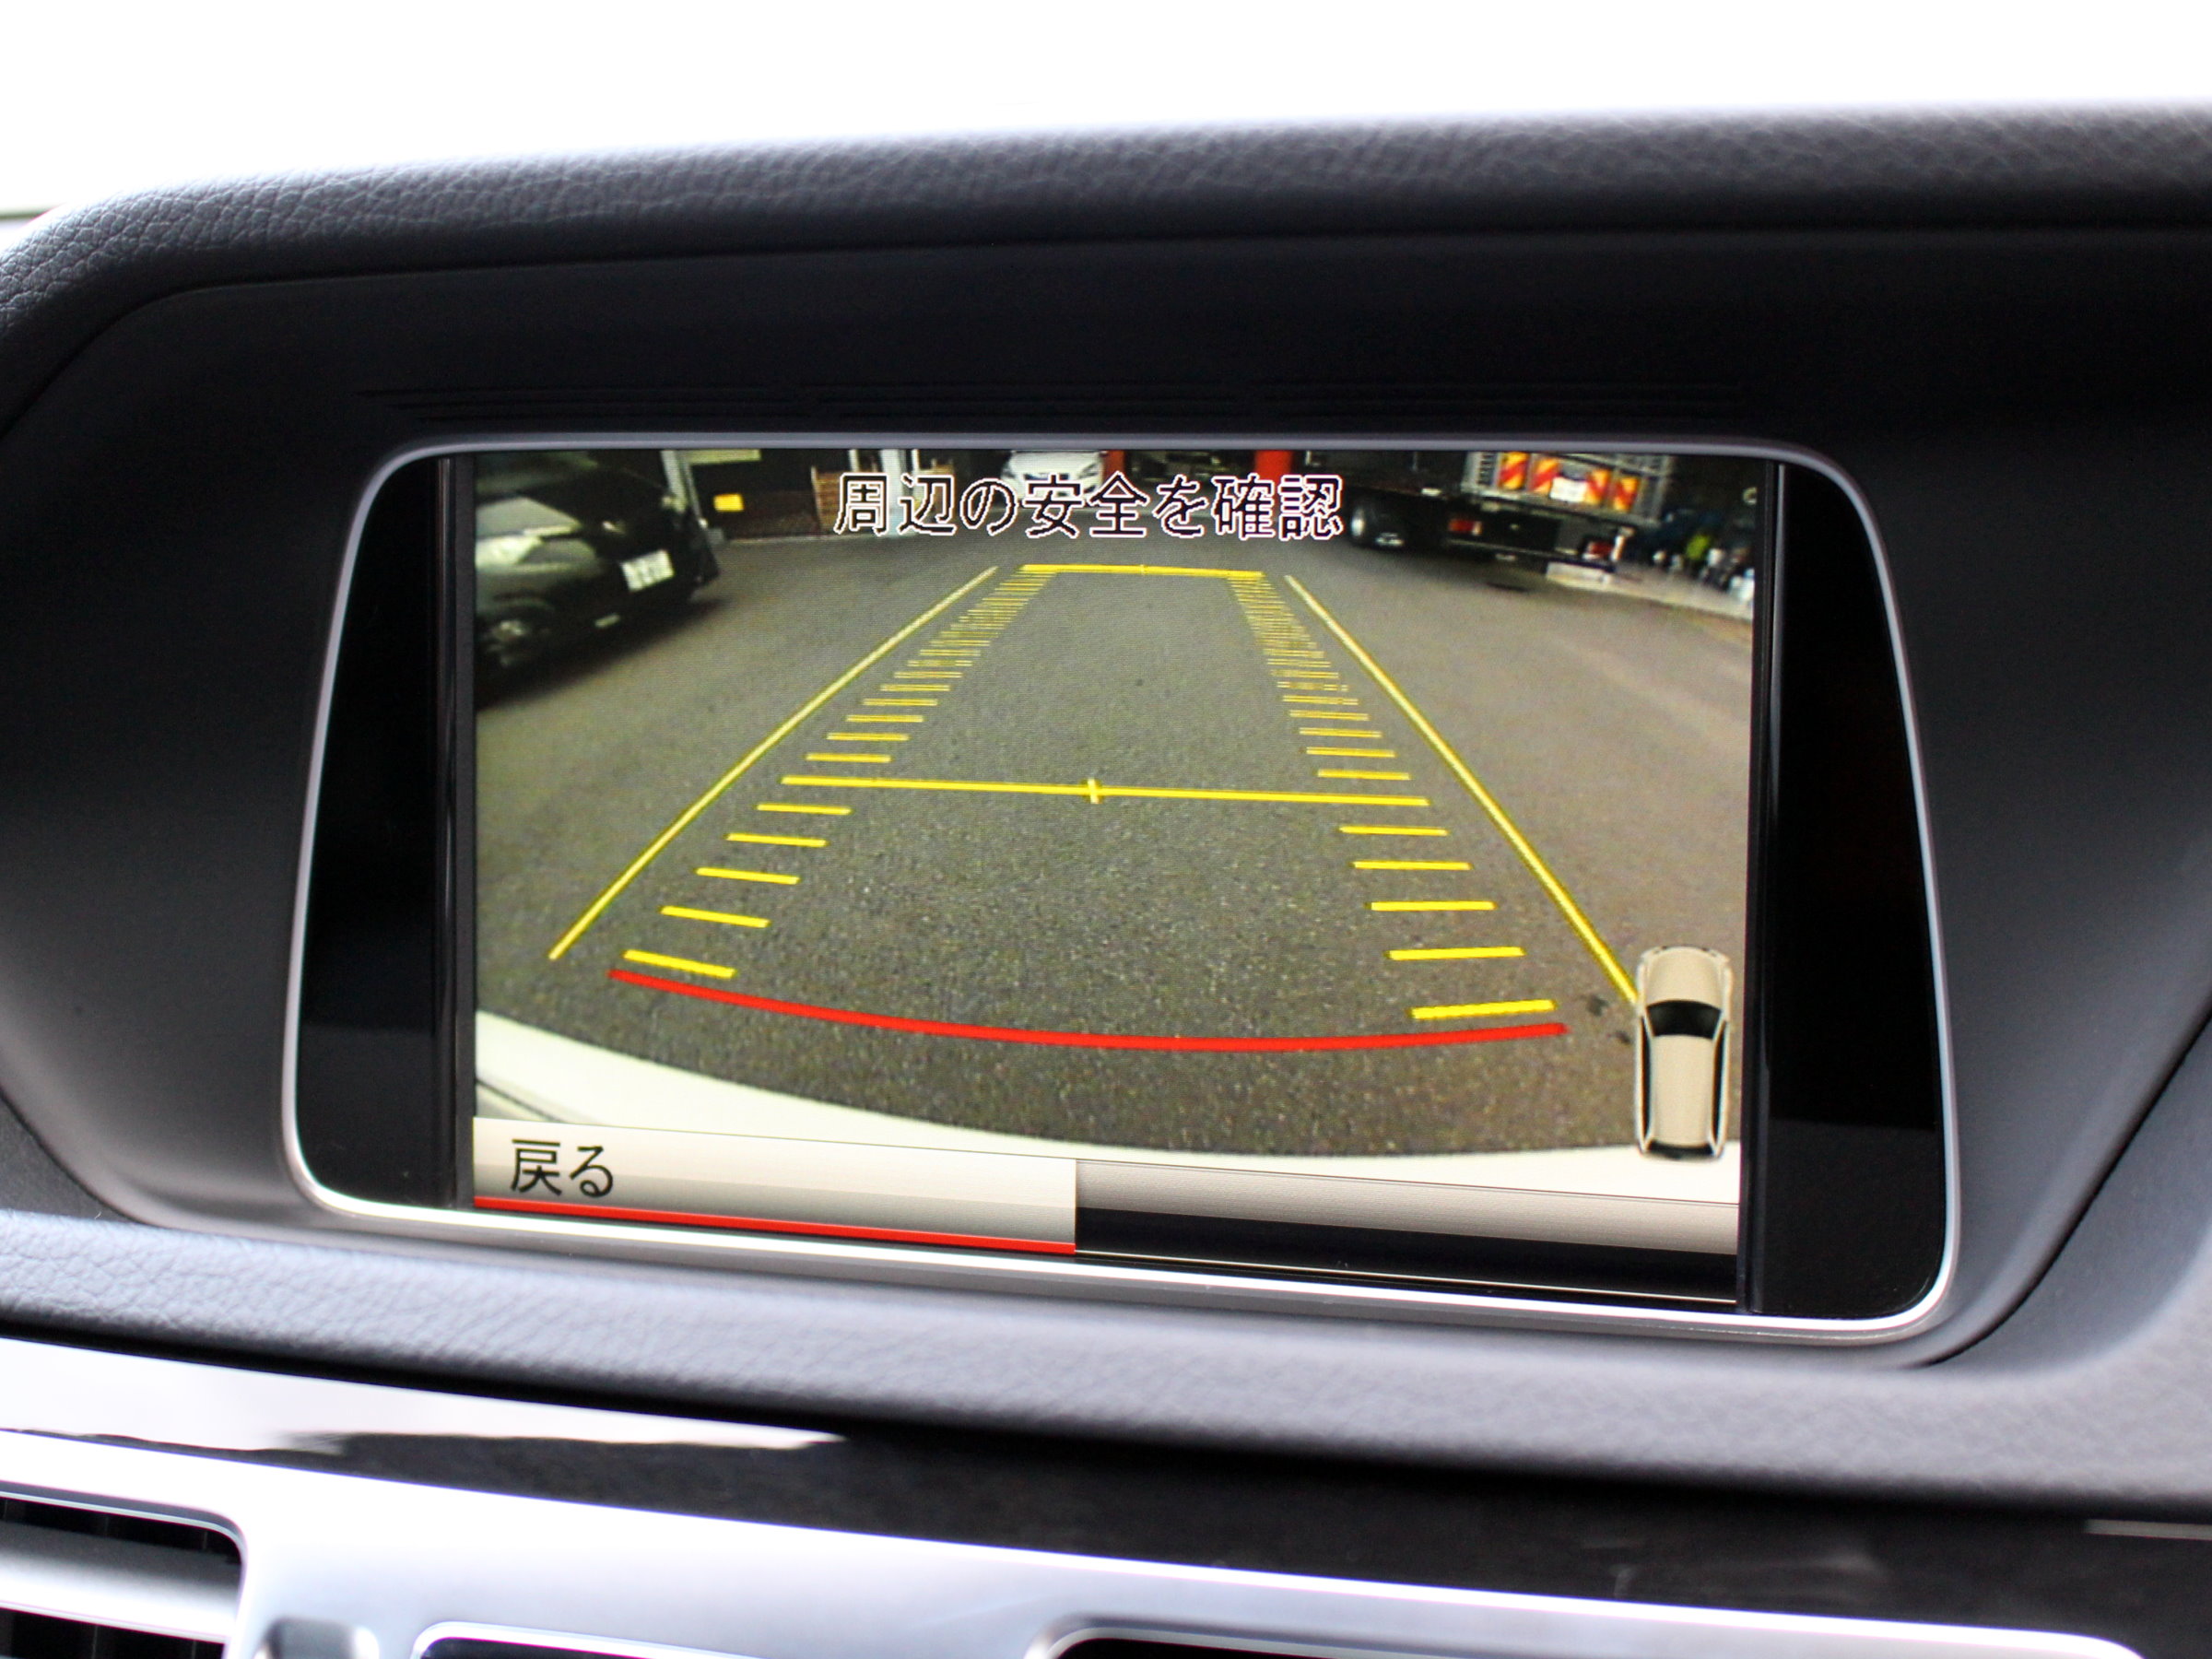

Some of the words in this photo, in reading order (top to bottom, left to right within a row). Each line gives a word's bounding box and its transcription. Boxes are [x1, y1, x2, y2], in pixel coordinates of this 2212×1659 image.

[833, 471, 1343, 541] 周辺の安全を確認
[510, 1138, 614, 1198] 戻る
